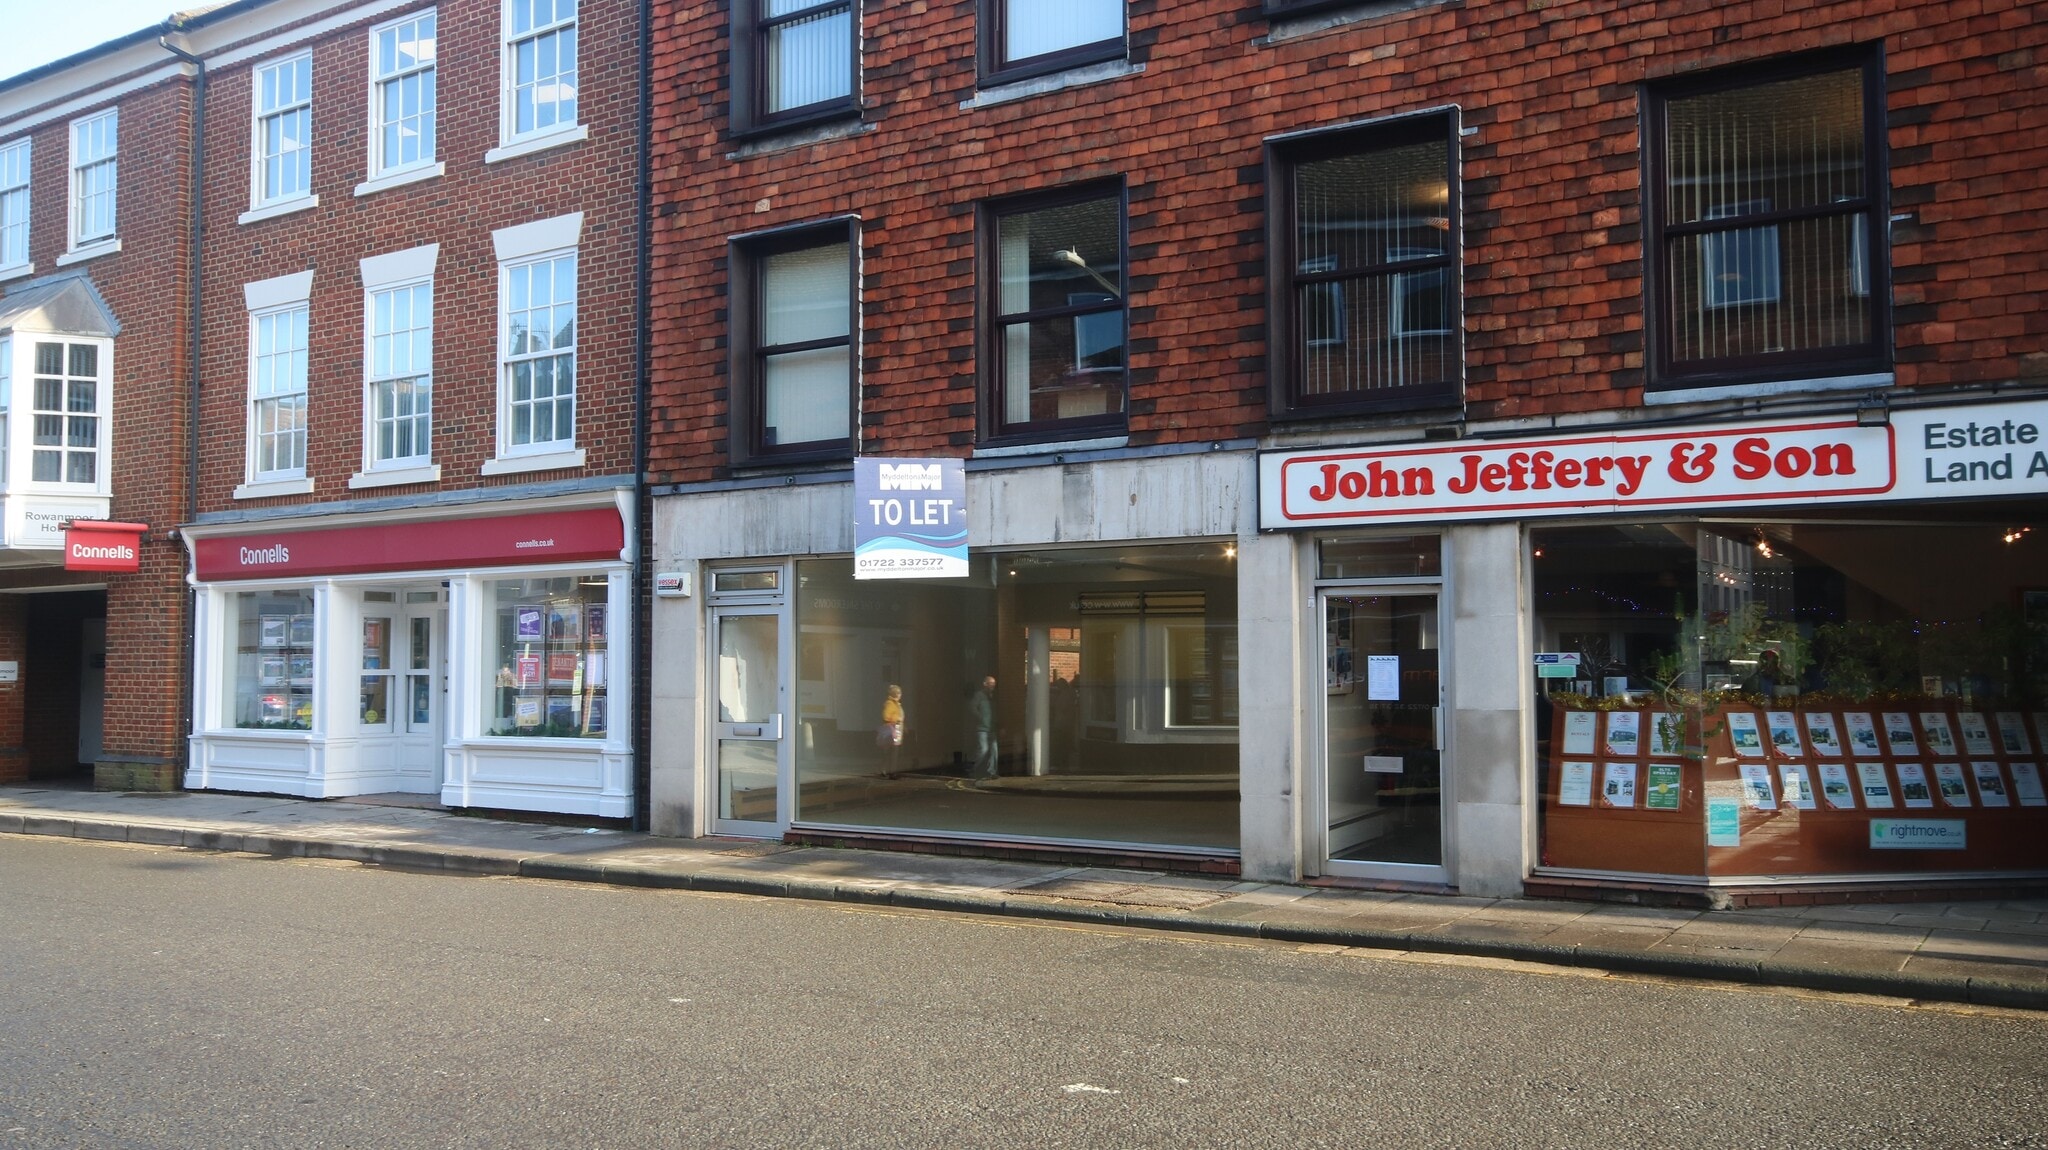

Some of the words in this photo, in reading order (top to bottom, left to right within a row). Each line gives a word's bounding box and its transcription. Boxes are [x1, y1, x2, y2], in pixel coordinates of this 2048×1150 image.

[1924, 419, 2039, 449] Estate
[1309, 460, 1435, 502] John
[1447, 450, 1652, 497] Jeffery
[1666, 441, 1718, 484] &
[1732, 437, 1857, 480] Son
[1925, 452, 2013, 483] Land
[869, 498, 903, 526] TO
[909, 499, 953, 525] LET
[72, 543, 134, 560] Connells
[240, 543, 290, 565] Connells
[515, 538, 554, 548] connells.co.uk
[859, 559, 895, 567] 01722
[899, 558, 944, 566] 337577
